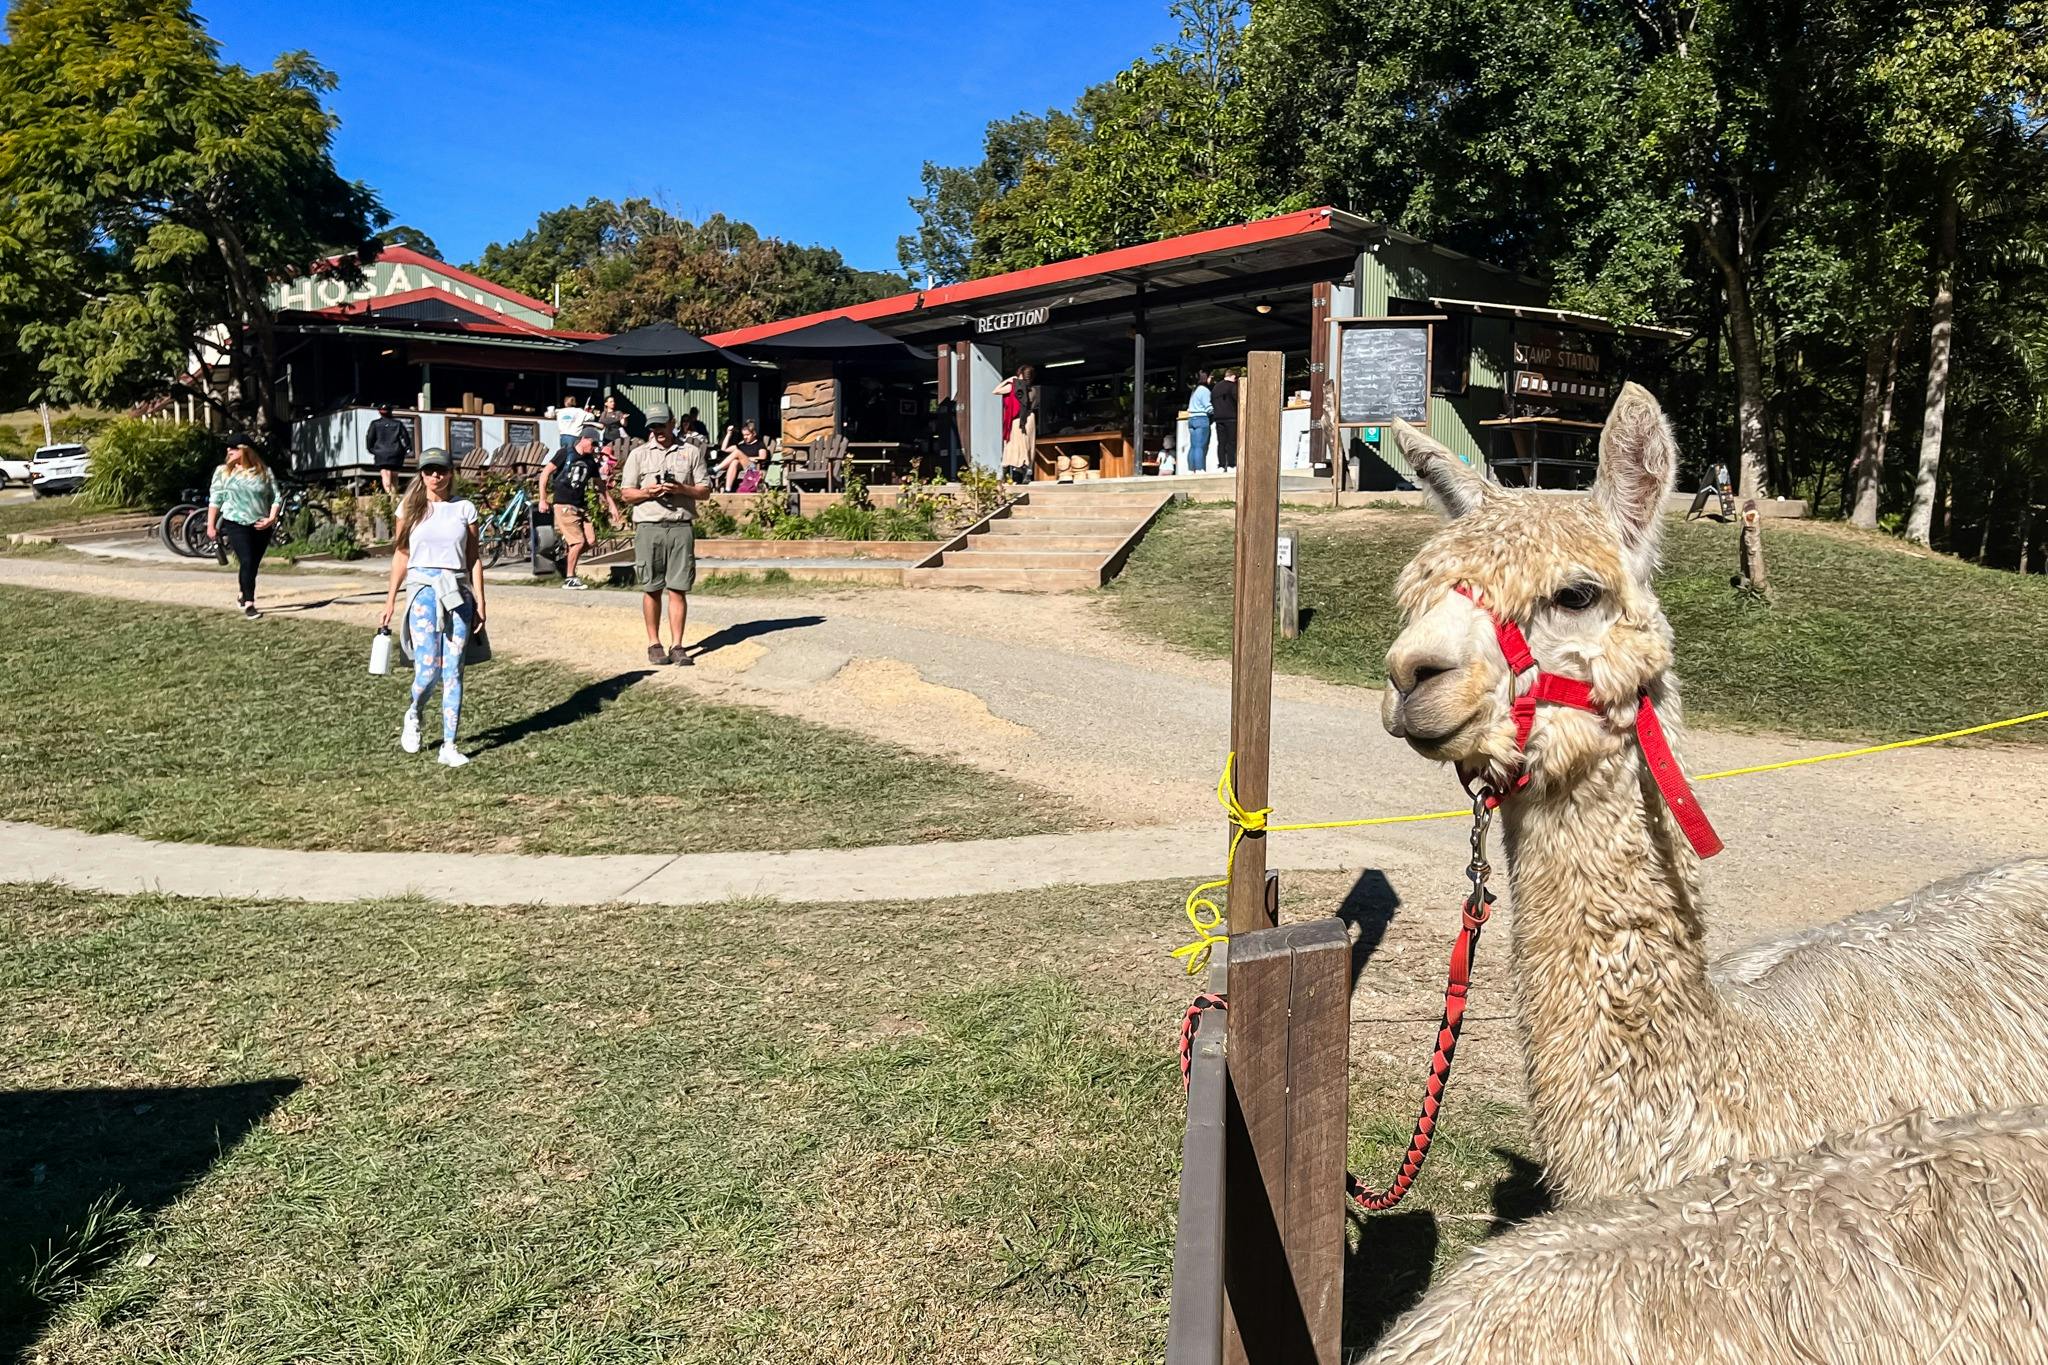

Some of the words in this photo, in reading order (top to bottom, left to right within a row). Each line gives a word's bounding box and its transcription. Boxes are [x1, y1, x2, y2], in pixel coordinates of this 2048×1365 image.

[279, 263, 504, 313] HOSA
[977, 308, 1044, 333] RECEPTION
[1514, 343, 1552, 365] STAMP
[1558, 350, 1600, 372] STATION
